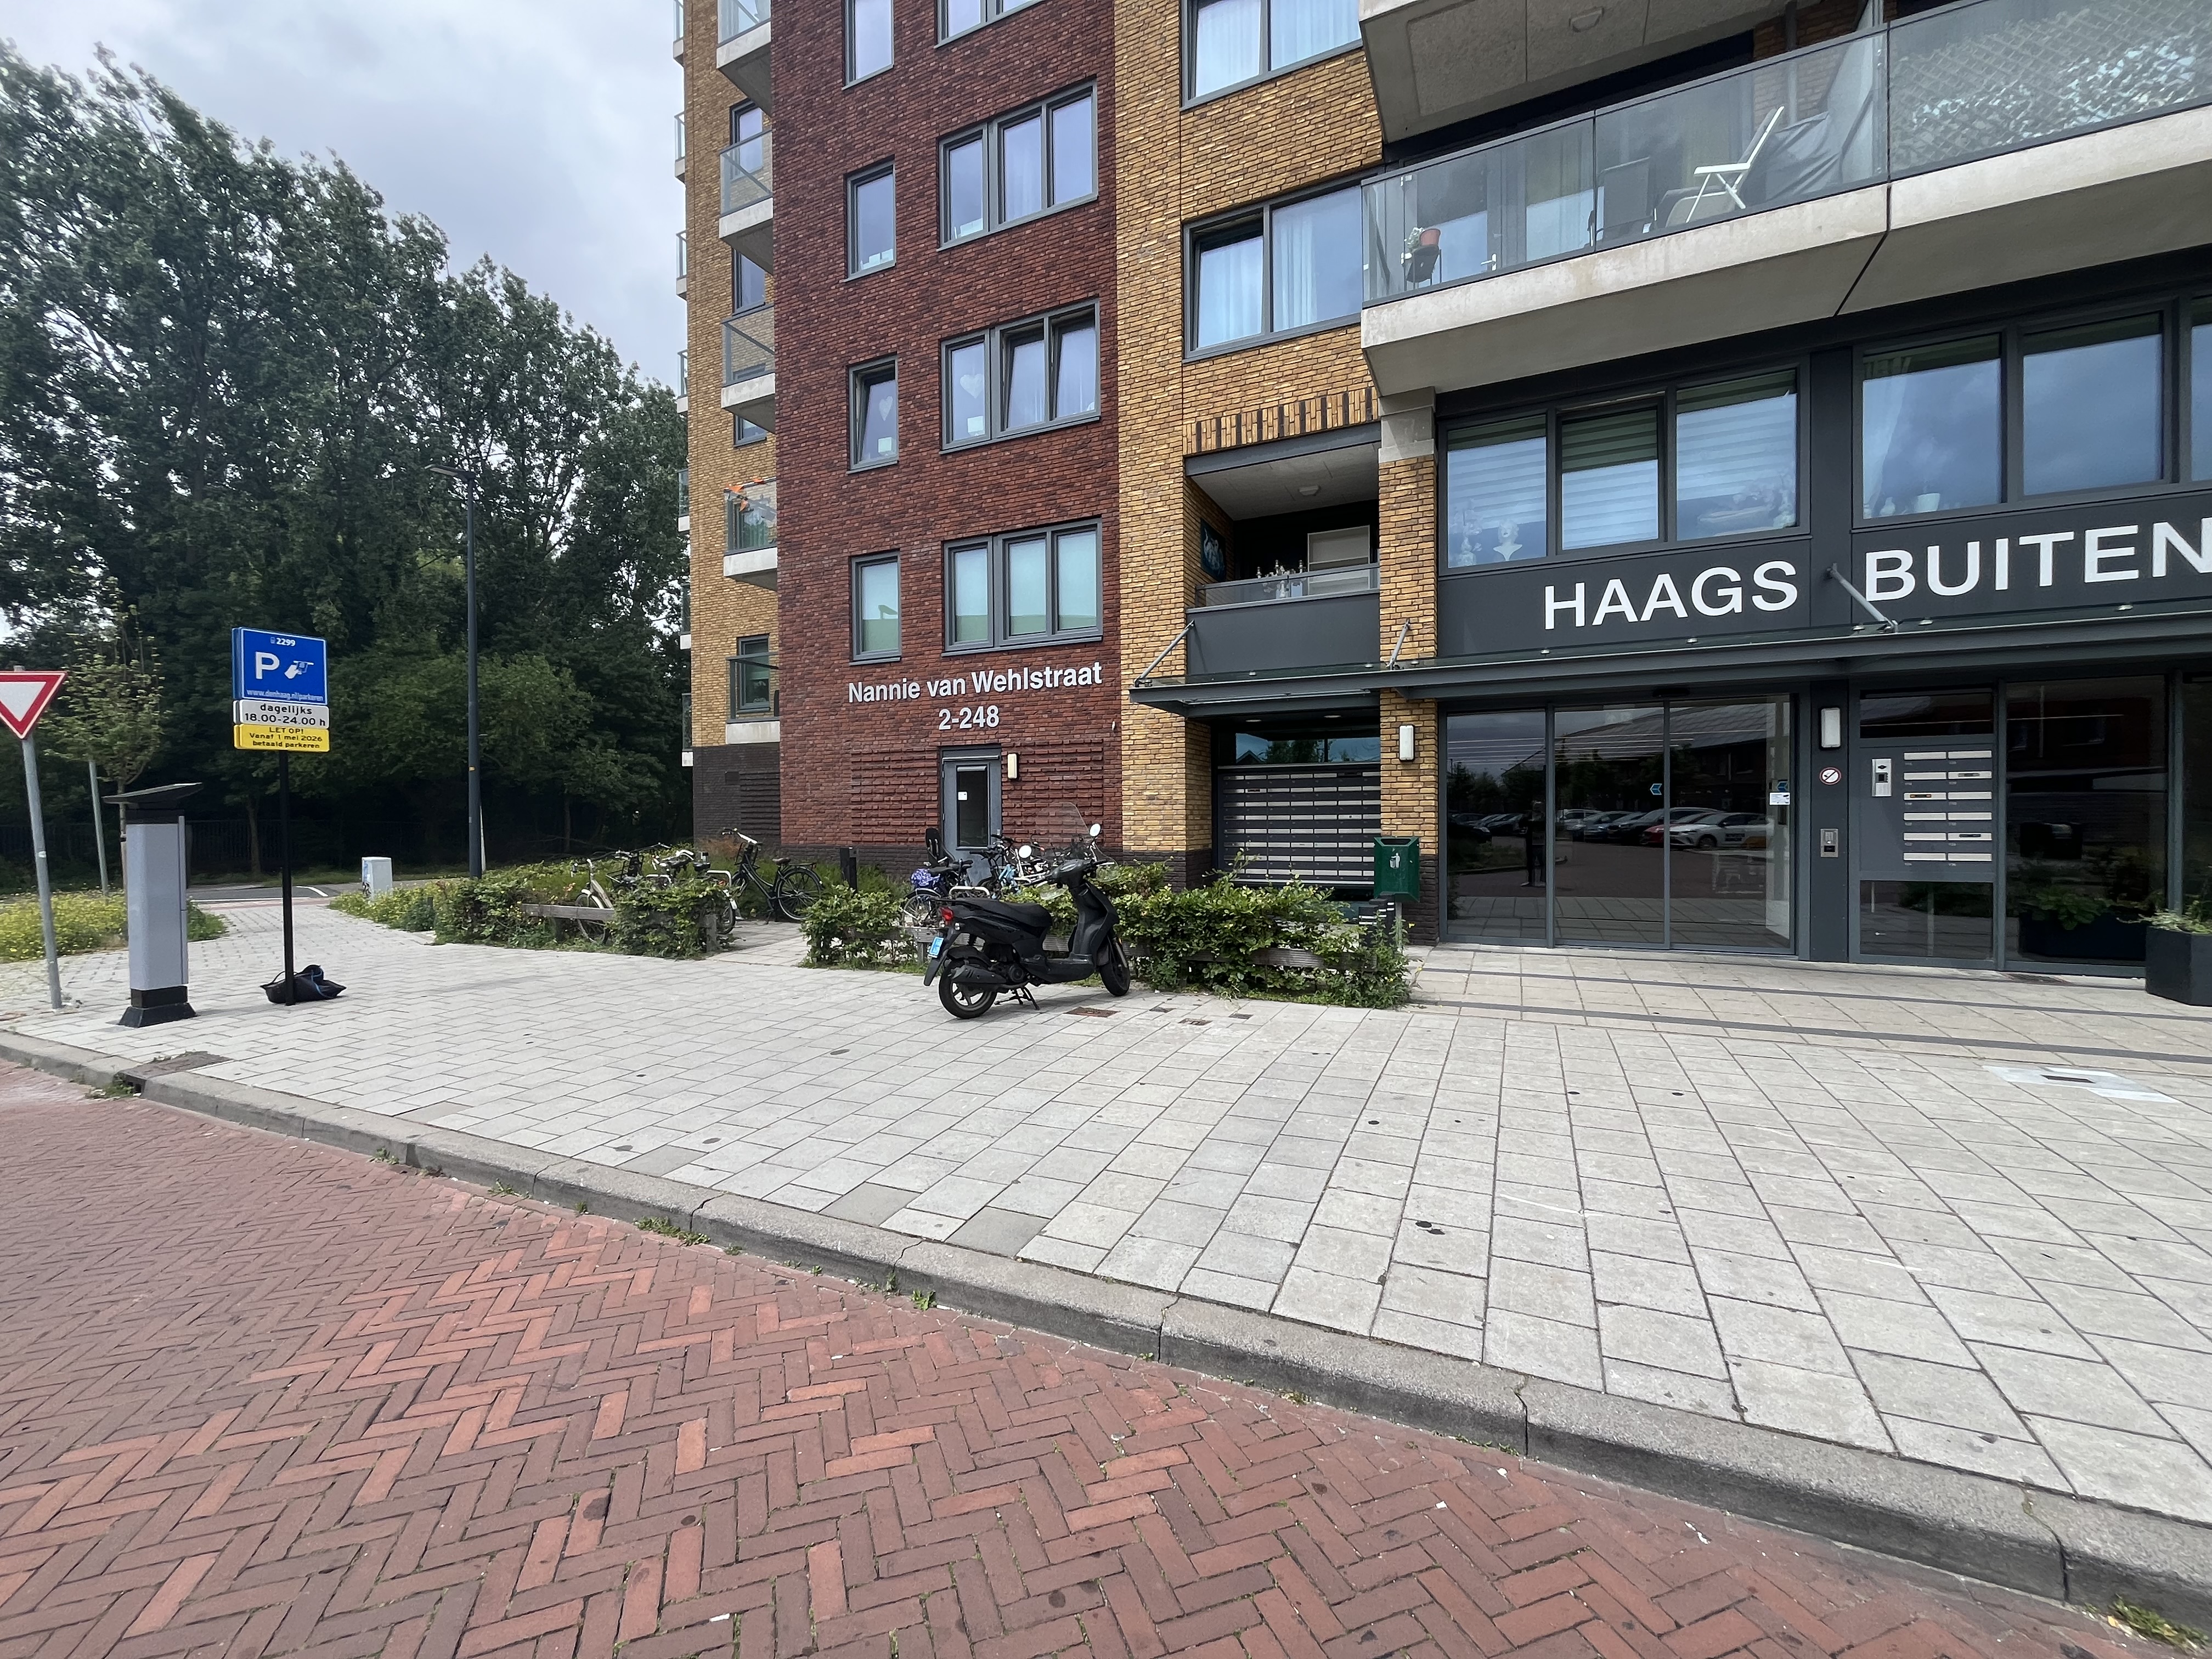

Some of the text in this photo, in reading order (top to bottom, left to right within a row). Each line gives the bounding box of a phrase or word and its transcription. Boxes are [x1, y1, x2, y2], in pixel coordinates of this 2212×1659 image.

[1544, 517, 2212, 630] HAAGS BUITEN
[276, 637, 296, 646] 2299
[255, 651, 280, 680] P
[849, 662, 1103, 703] Nannie van Wehlstraat
[245, 713, 315, 725] 18.00-24.00
[260, 703, 312, 715] dagelijks
[939, 705, 1000, 731] 2-248
